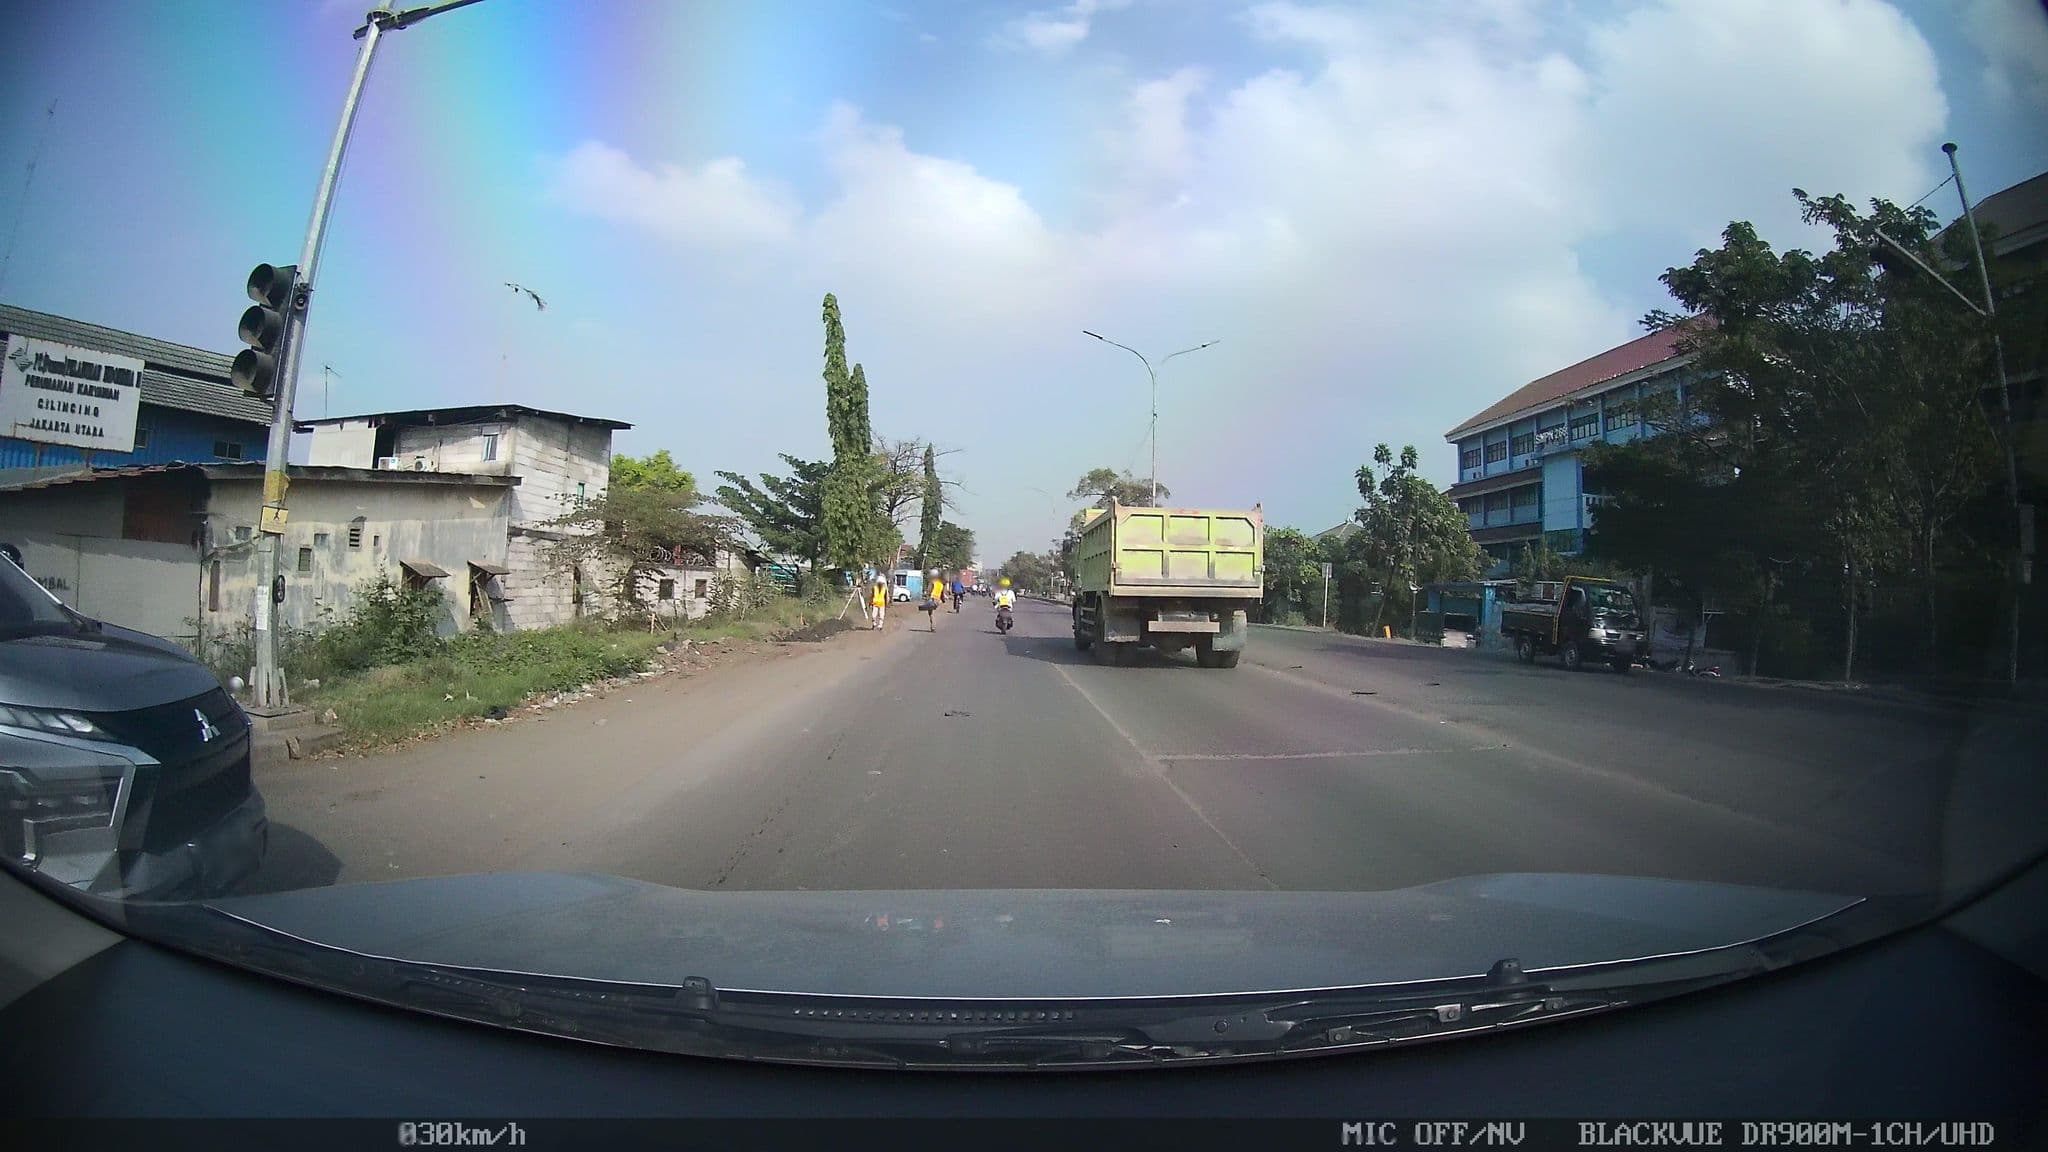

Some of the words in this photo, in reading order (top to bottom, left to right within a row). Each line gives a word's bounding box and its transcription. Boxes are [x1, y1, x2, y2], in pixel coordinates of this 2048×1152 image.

[30, 418, 71, 434] JAKARTA
[75, 424, 105, 437] UTARA
[33, 576, 70, 590] MBAL
